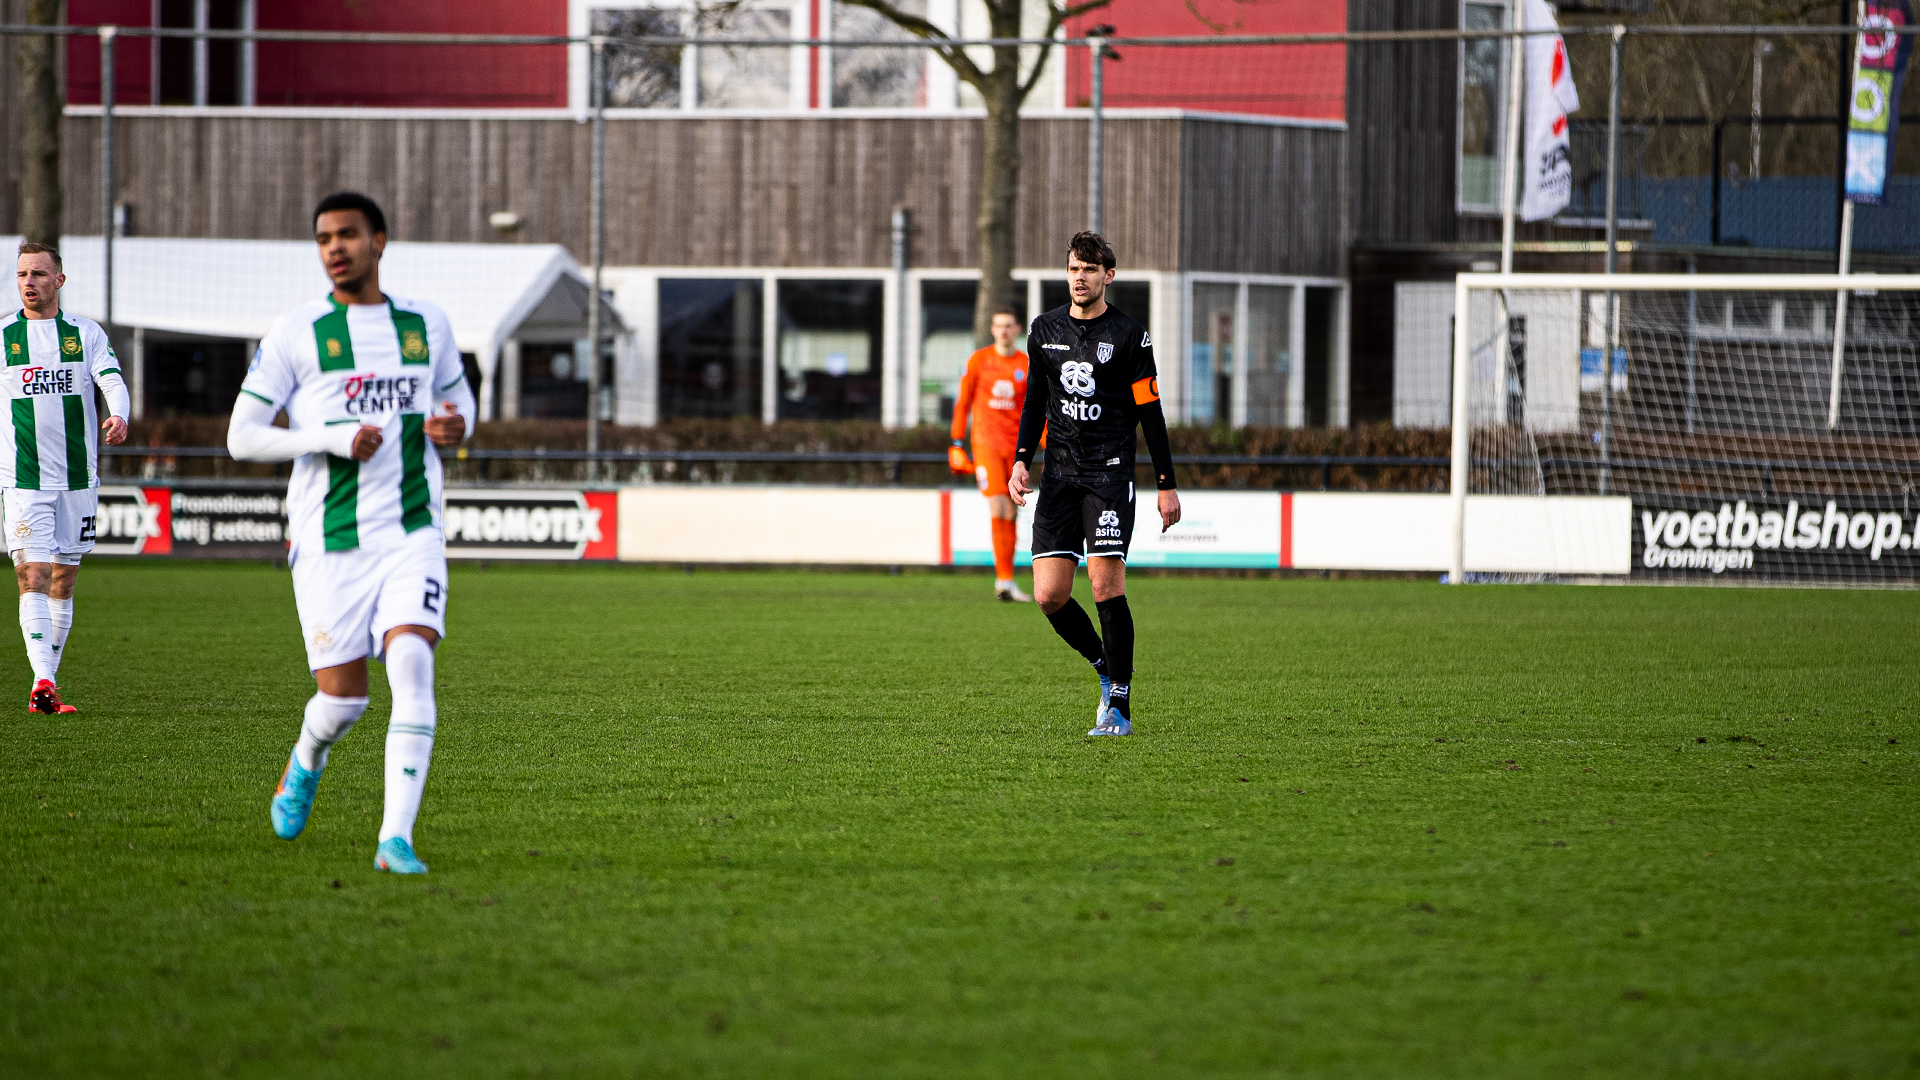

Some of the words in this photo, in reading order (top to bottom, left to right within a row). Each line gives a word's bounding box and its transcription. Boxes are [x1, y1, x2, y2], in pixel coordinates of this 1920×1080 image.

[21, 366, 73, 383] OFFICE
[343, 374, 419, 399] OFFICE
[22, 381, 73, 396] CENTRE
[1060, 396, 1102, 421] asito
[95, 503, 161, 539] OTEX
[443, 506, 603, 543] PROMOTEX
[1095, 526, 1122, 538] asito
[1641, 499, 1920, 561] voetbalshop.
